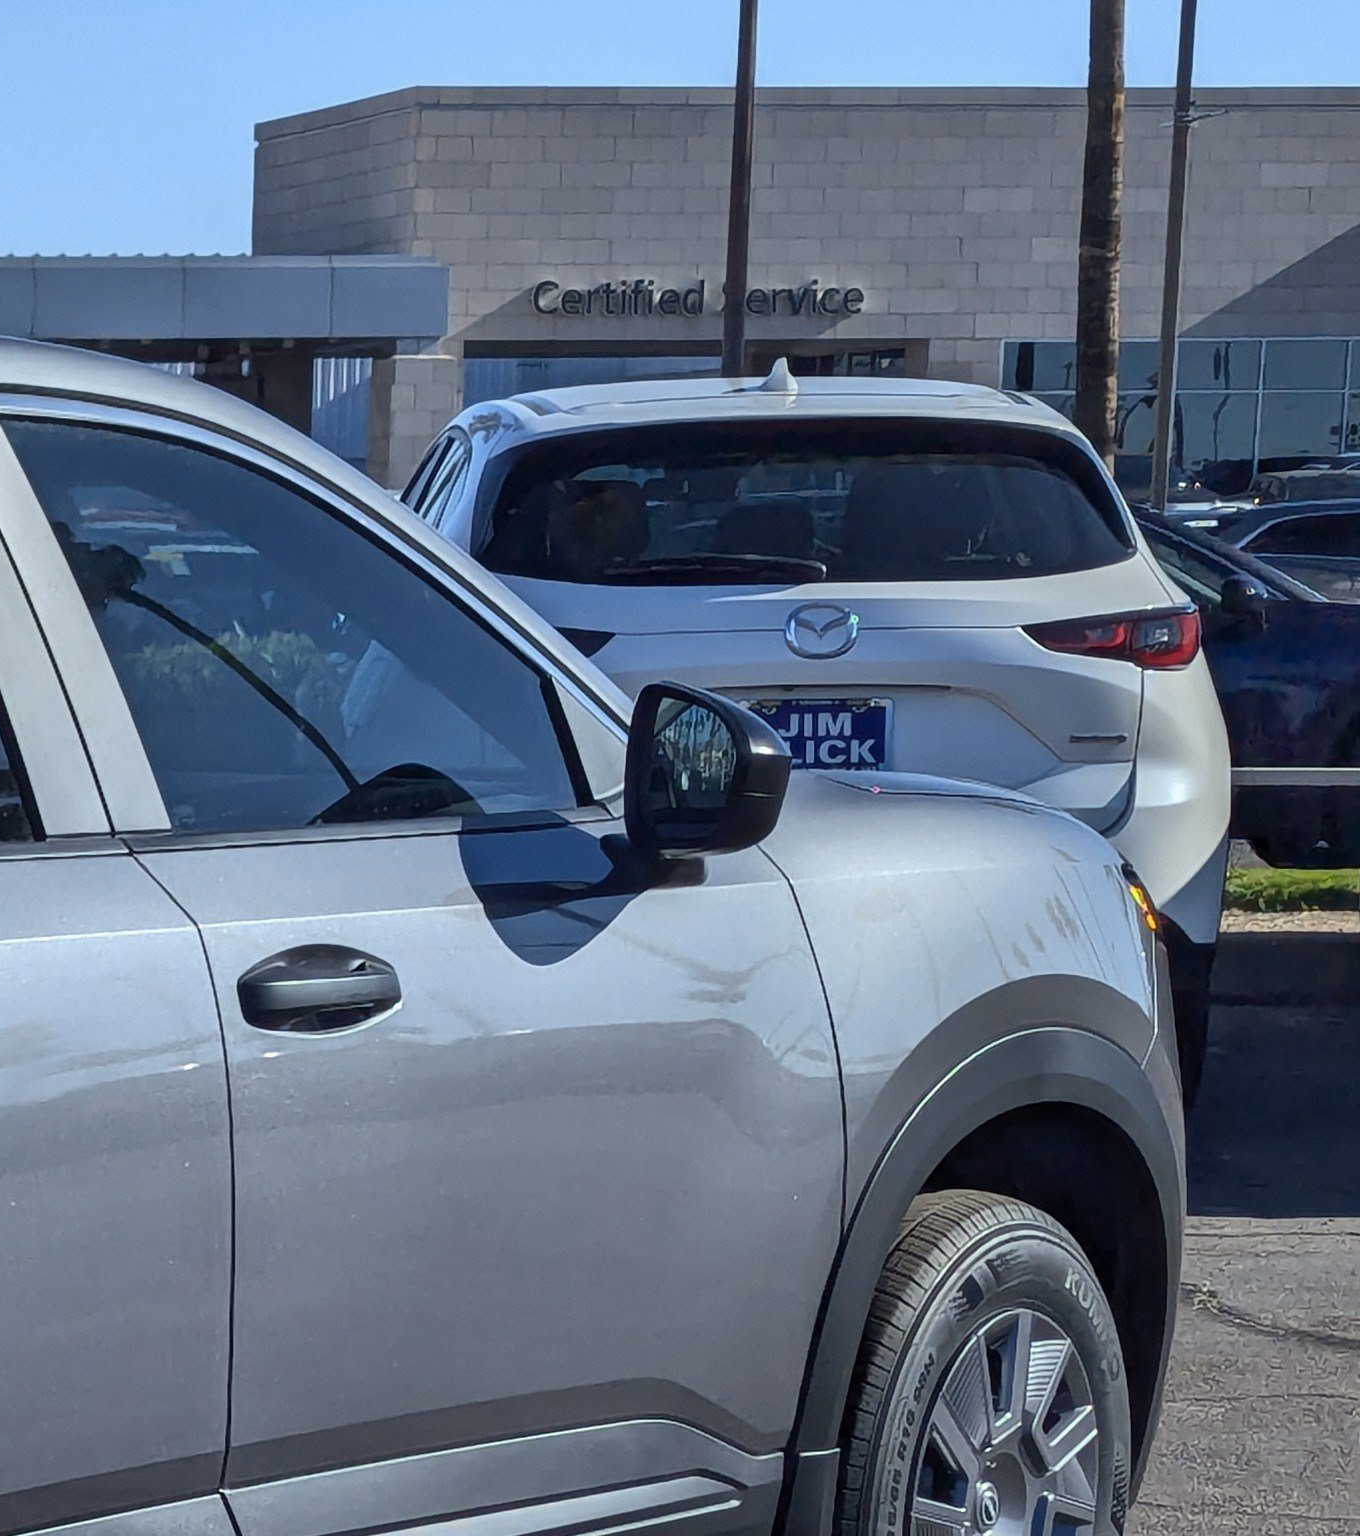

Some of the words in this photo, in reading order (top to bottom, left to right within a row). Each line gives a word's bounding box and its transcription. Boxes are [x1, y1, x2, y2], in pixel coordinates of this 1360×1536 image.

[533, 280, 705, 315] Certified
[720, 279, 865, 315] ervice
[778, 712, 852, 737] JIM
[783, 739, 877, 764] ICK
